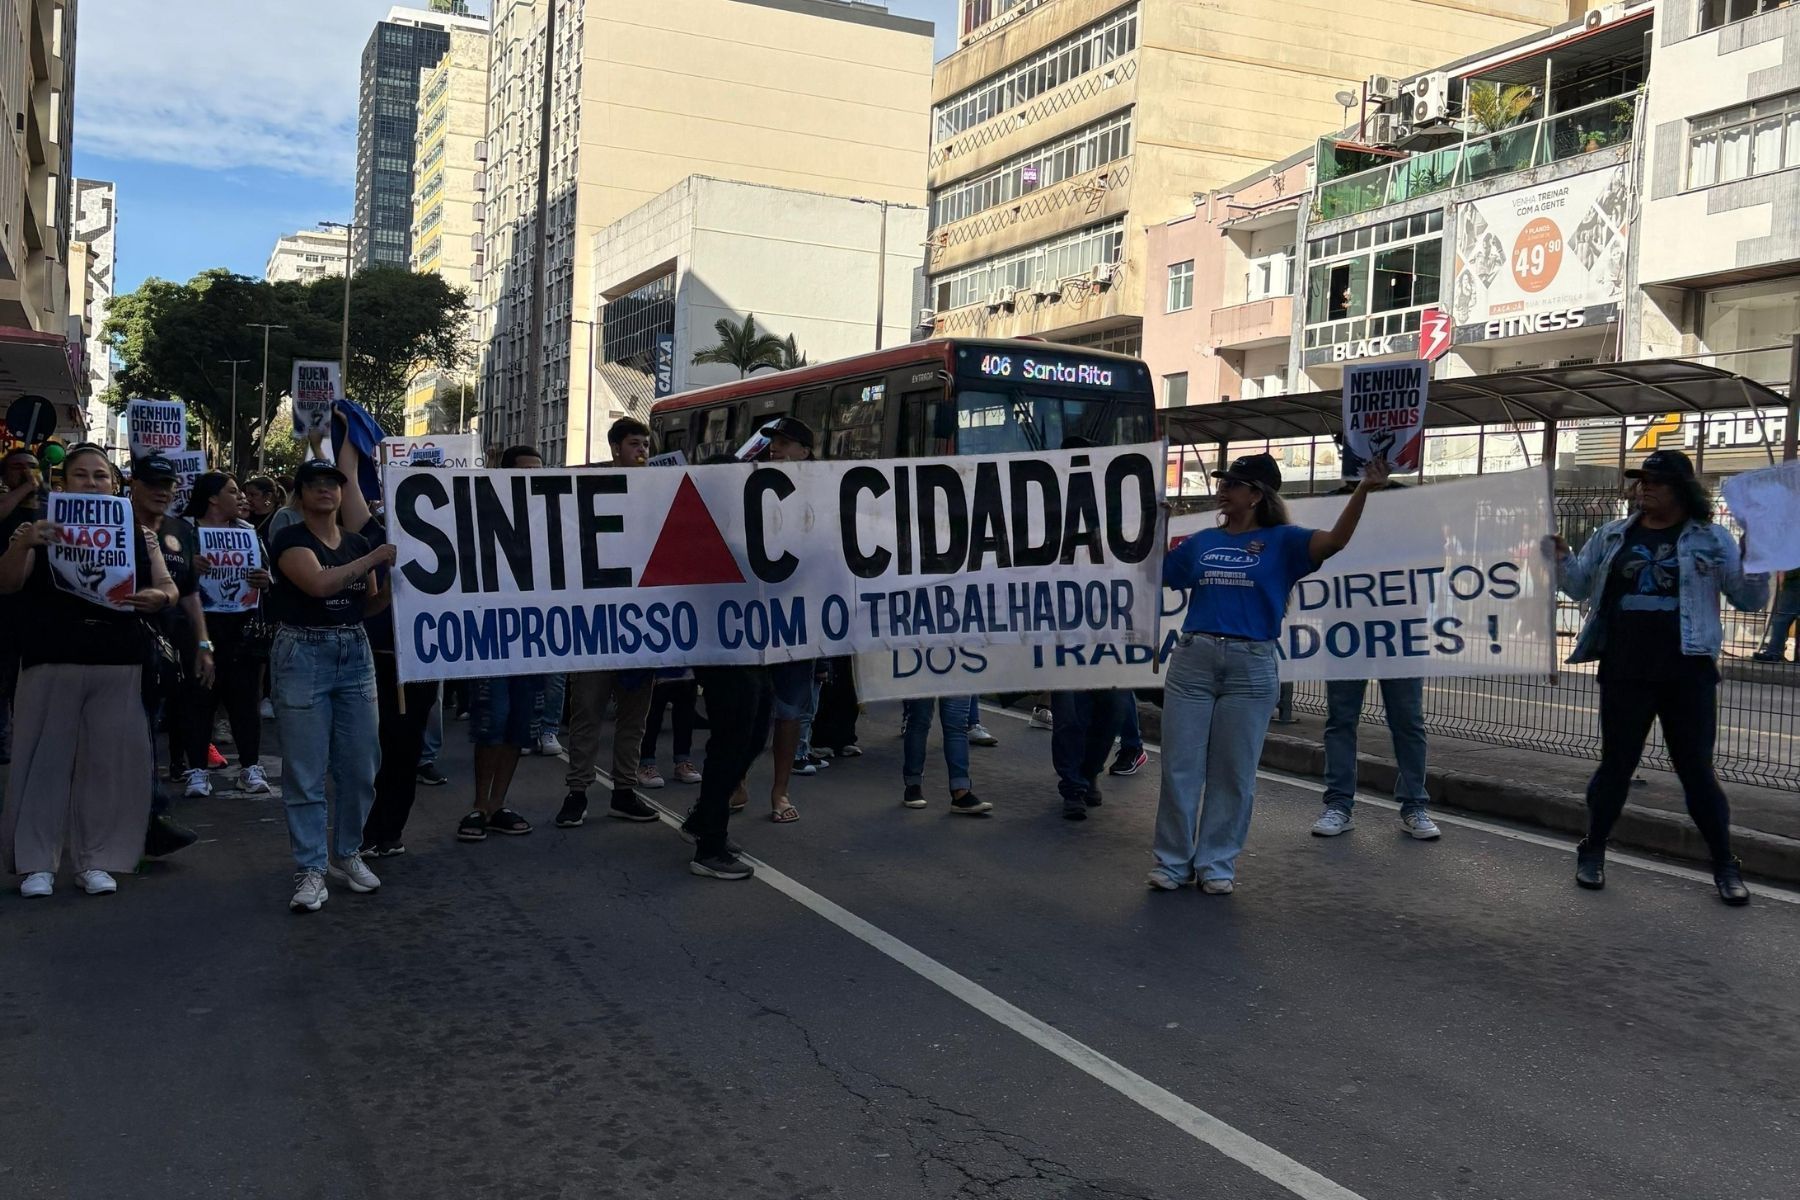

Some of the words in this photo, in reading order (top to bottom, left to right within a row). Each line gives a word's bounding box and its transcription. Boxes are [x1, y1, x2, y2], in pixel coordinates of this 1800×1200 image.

[1538, 187, 1569, 201] TREINAR
[1517, 206, 1533, 216] COM
[1534, 204, 1540, 213] A
[1541, 198, 1565, 211] GENTE
[1484, 306, 1585, 340] FITNESS
[1333, 337, 1394, 361] BLACK
[659, 341, 673, 393] CAIXA
[981, 355, 1011, 376] 406
[1023, 359, 1075, 383] Santa
[1078, 364, 1112, 386] Rita
[1351, 368, 1422, 394] NENHUM
[131, 404, 181, 421] NENHUM
[1350, 389, 1420, 413] DIREITO
[132, 420, 181, 435] DIREITO
[1350, 414, 1360, 431] A
[1364, 409, 1419, 429] MENOS
[133, 433, 140, 444] A
[142, 433, 181, 446] MENOS
[55, 499, 124, 525] DIREITO
[839, 453, 1157, 579] CIDADÃO
[54, 525, 111, 549] NÃO
[116, 526, 127, 549] É
[204, 531, 252, 550] DIREITO
[206, 549, 245, 567] NÃO
[247, 550, 255, 567] É
[1299, 561, 1521, 611] DIREITOS
[413, 600, 699, 664] COMPROMISSO
[717, 597, 808, 650] COM
[821, 594, 849, 641] O
[860, 579, 1134, 638] TRABALHADOR
